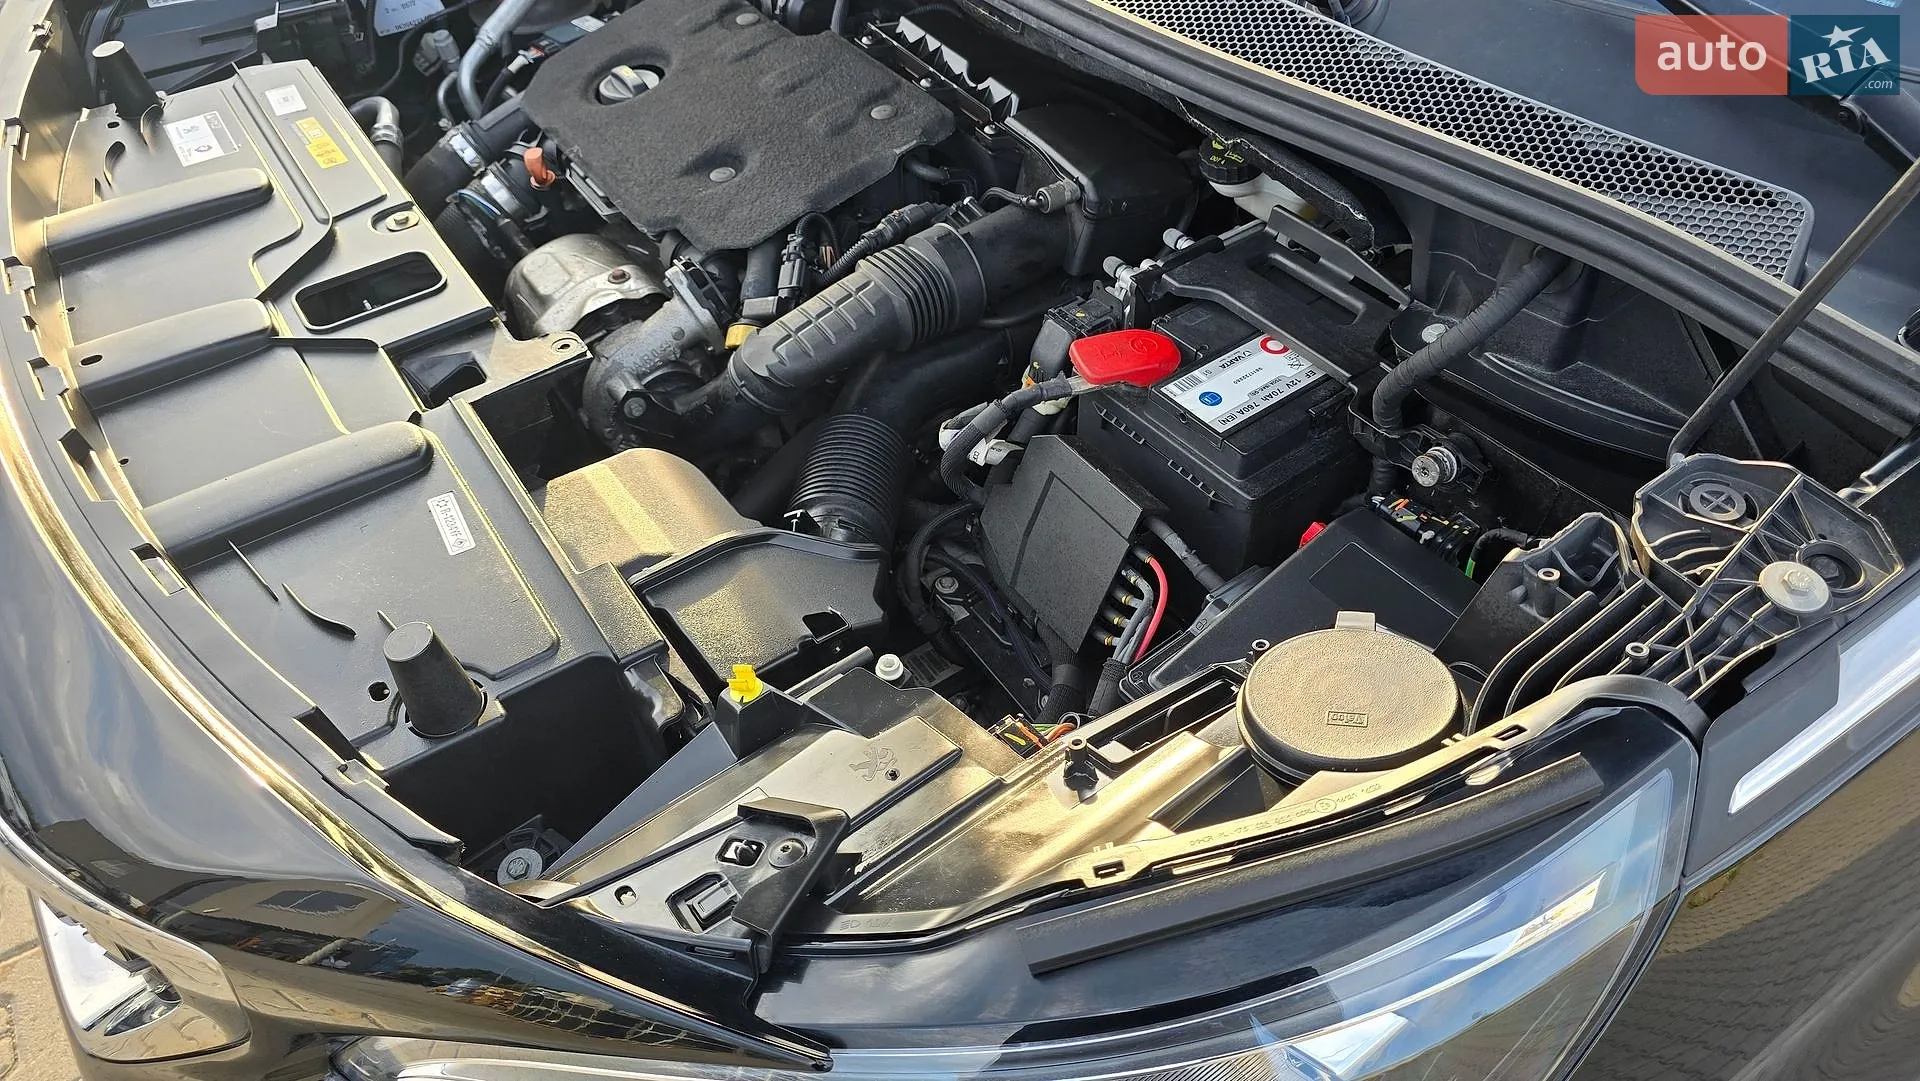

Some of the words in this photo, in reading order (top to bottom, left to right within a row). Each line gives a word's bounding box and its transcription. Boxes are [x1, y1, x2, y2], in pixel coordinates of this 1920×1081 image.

[1218, 353, 1245, 370] VARTA
[1286, 378, 1302, 390] 12V
[1261, 386, 1284, 402] 70Ah
[1238, 401, 1260, 416] 760A
[1219, 412, 1237, 426] (EN)
